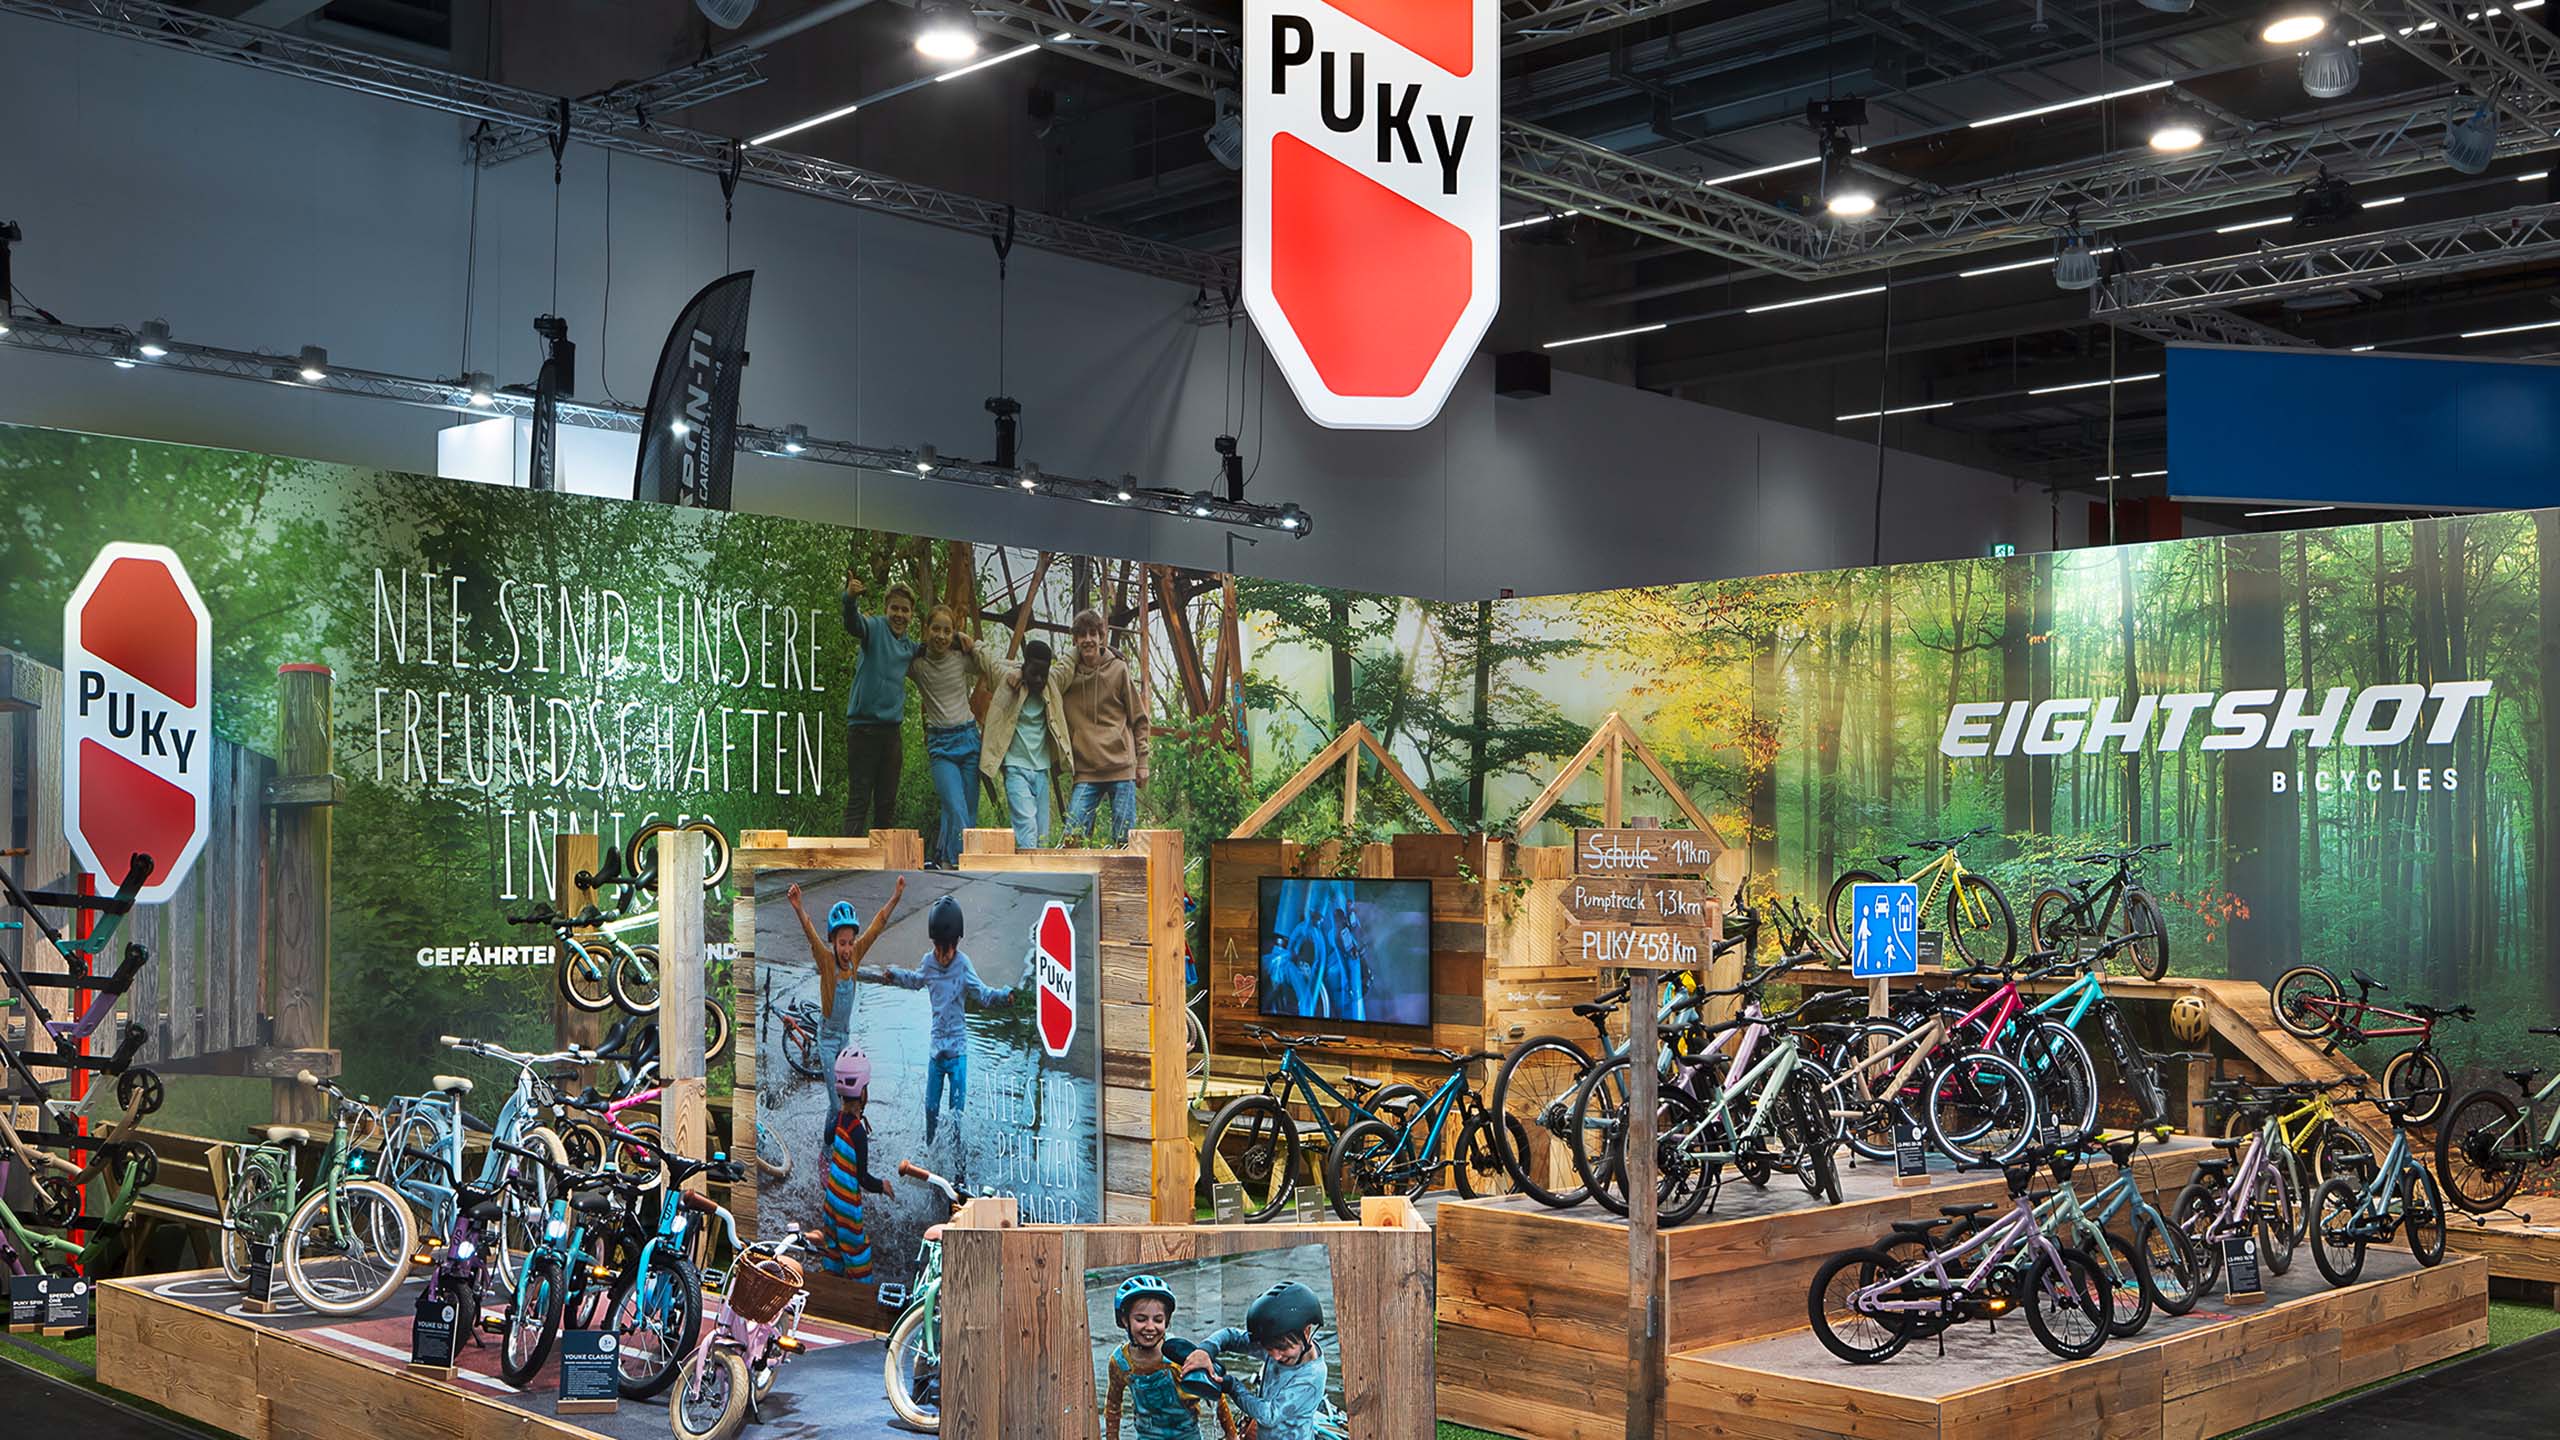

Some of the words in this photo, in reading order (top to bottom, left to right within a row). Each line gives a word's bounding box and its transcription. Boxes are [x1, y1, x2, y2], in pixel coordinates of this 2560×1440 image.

[1271, 14, 1474, 195] PUKY
[374, 567, 470, 669] NIE
[497, 579, 630, 677] SIND
[658, 593, 825, 692] UNSERE
[79, 670, 197, 774] PUKY
[375, 687, 823, 796] FREUNDSCHAFTEN
[1939, 680, 2493, 757] EIGHTSHOT
[2272, 767, 2458, 793] BICYCLES
[1583, 833, 1658, 870] Schule
[1575, 886, 1645, 912] Pumptrack
[1582, 930, 1636, 961] PUKY
[1638, 931, 1670, 962] 458
[1672, 933, 1697, 963] km
[1040, 956, 1072, 1001] PUKY
[985, 1072, 1018, 1124] NIE
[1025, 1076, 1077, 1130] SIND
[998, 1126, 1077, 1190] PFÜTZEN
